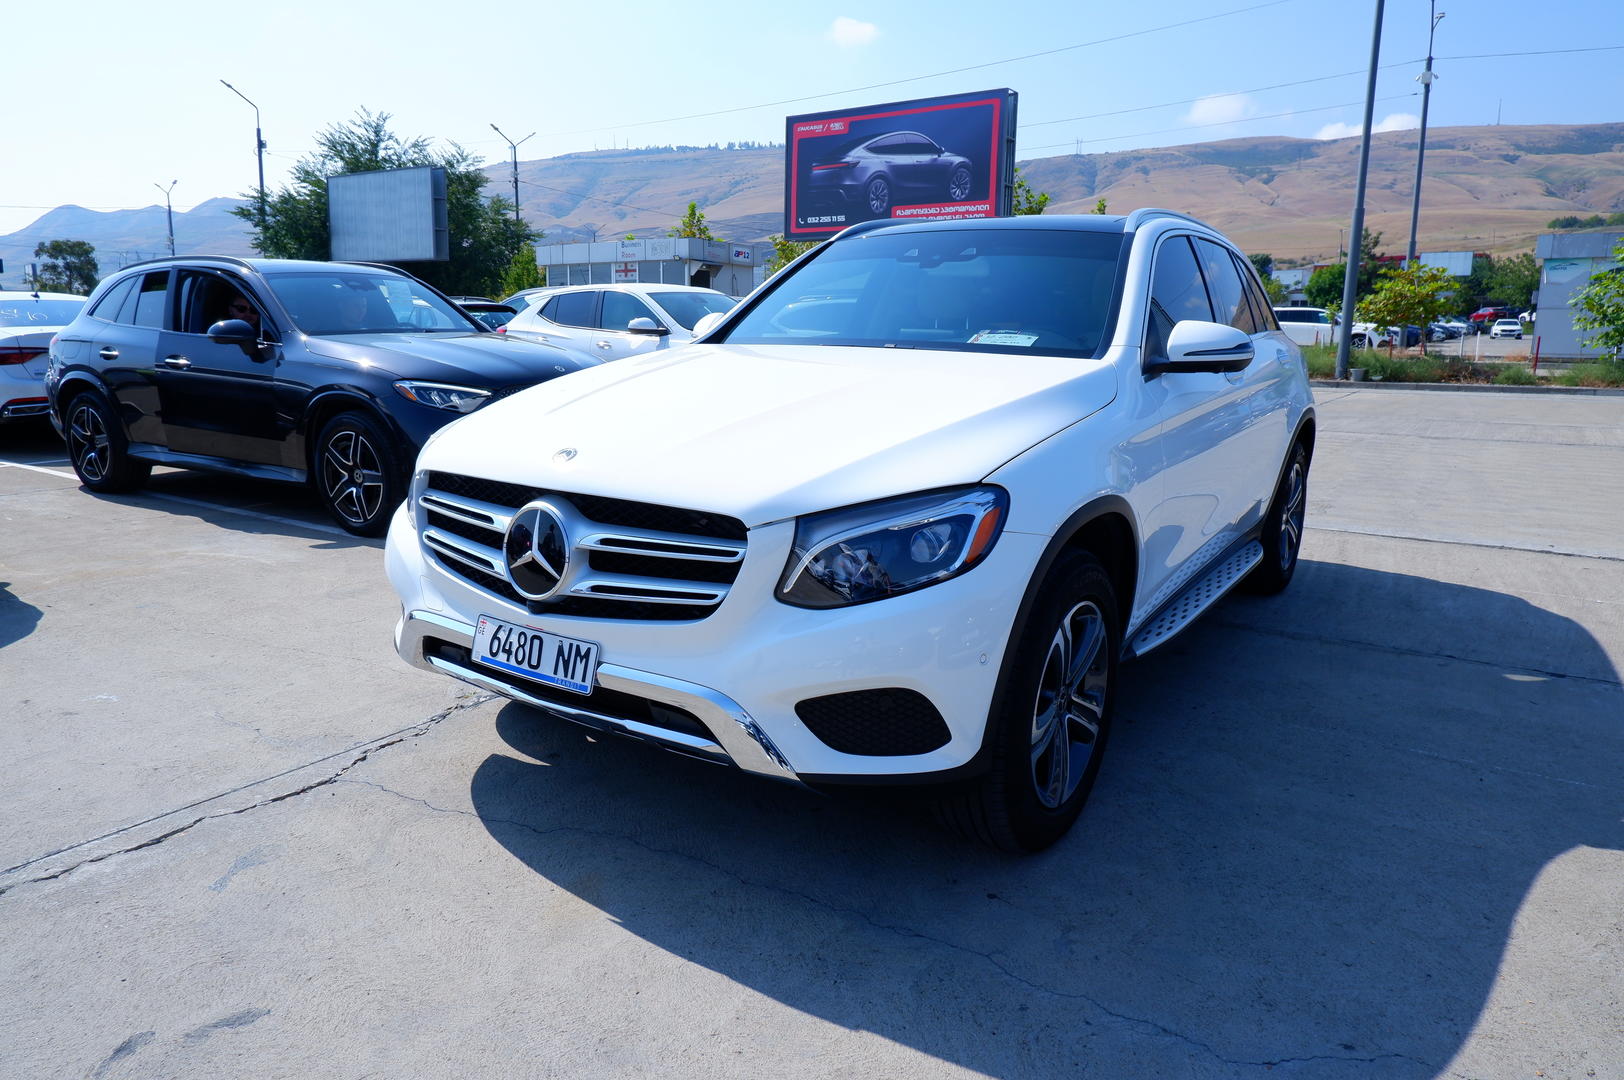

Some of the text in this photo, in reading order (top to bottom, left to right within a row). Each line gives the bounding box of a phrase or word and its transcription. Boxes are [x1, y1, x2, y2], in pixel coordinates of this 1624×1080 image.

[478, 626, 486, 636] GE
[489, 625, 592, 683] 6480 NM
